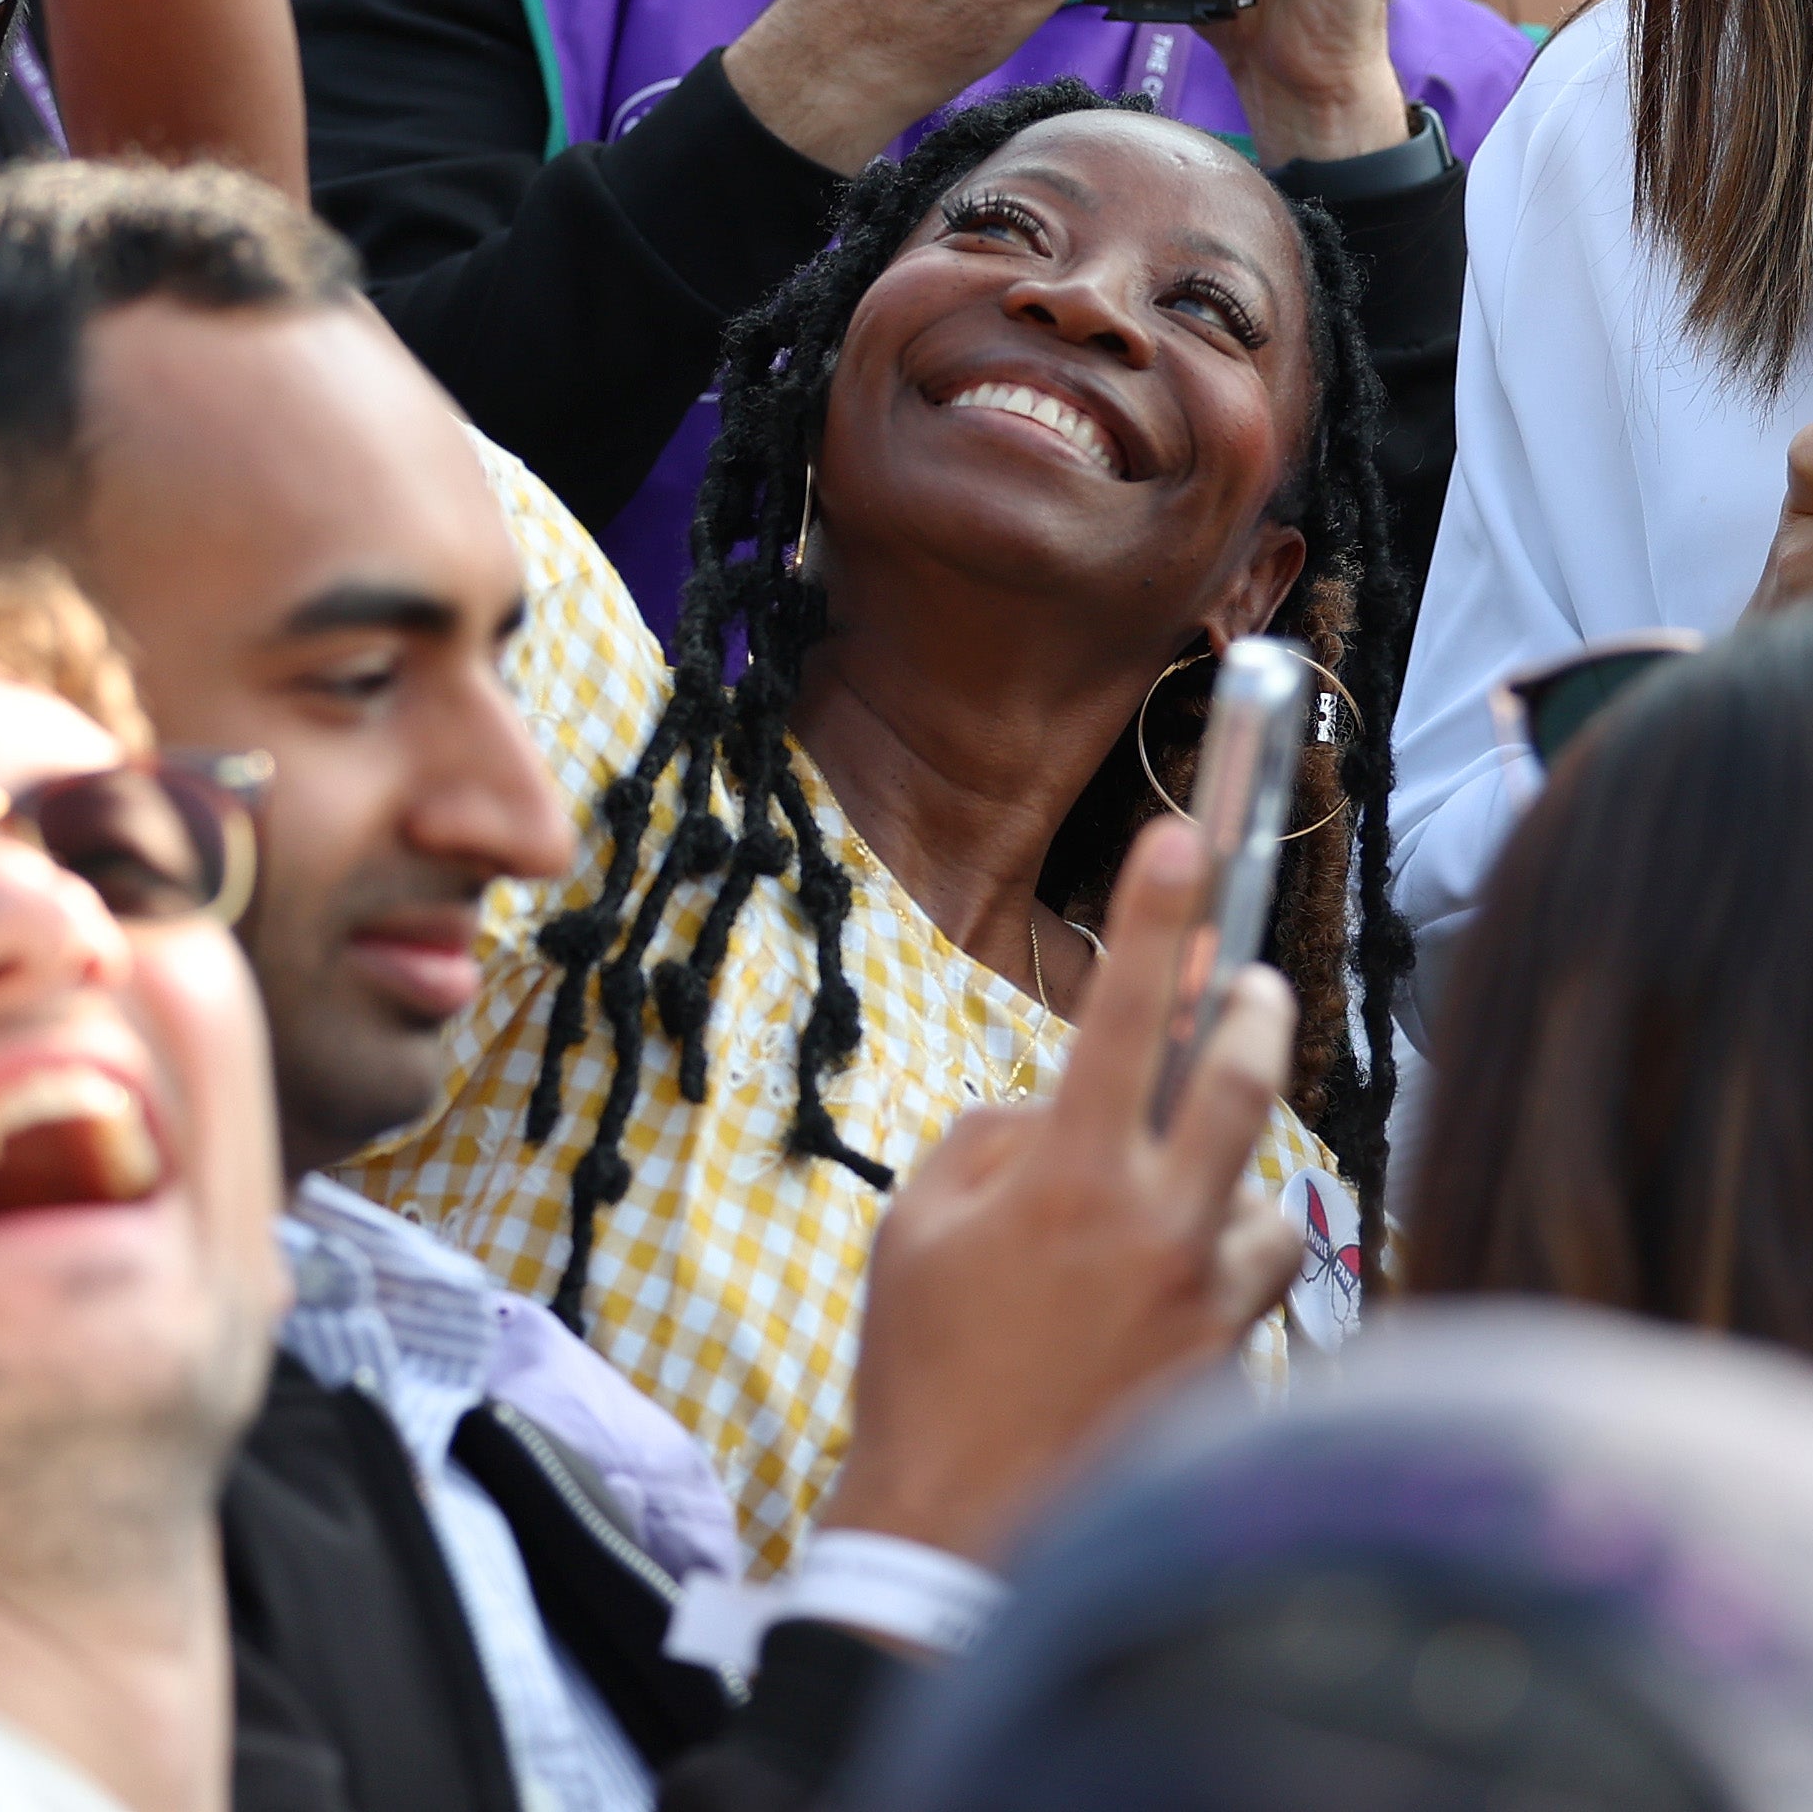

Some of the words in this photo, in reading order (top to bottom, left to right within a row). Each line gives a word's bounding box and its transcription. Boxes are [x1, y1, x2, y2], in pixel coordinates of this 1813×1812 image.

[1145, 33, 1174, 76] THE
[1308, 1224, 1329, 1259] NOLE
[1334, 1258, 1353, 1289] FAM
